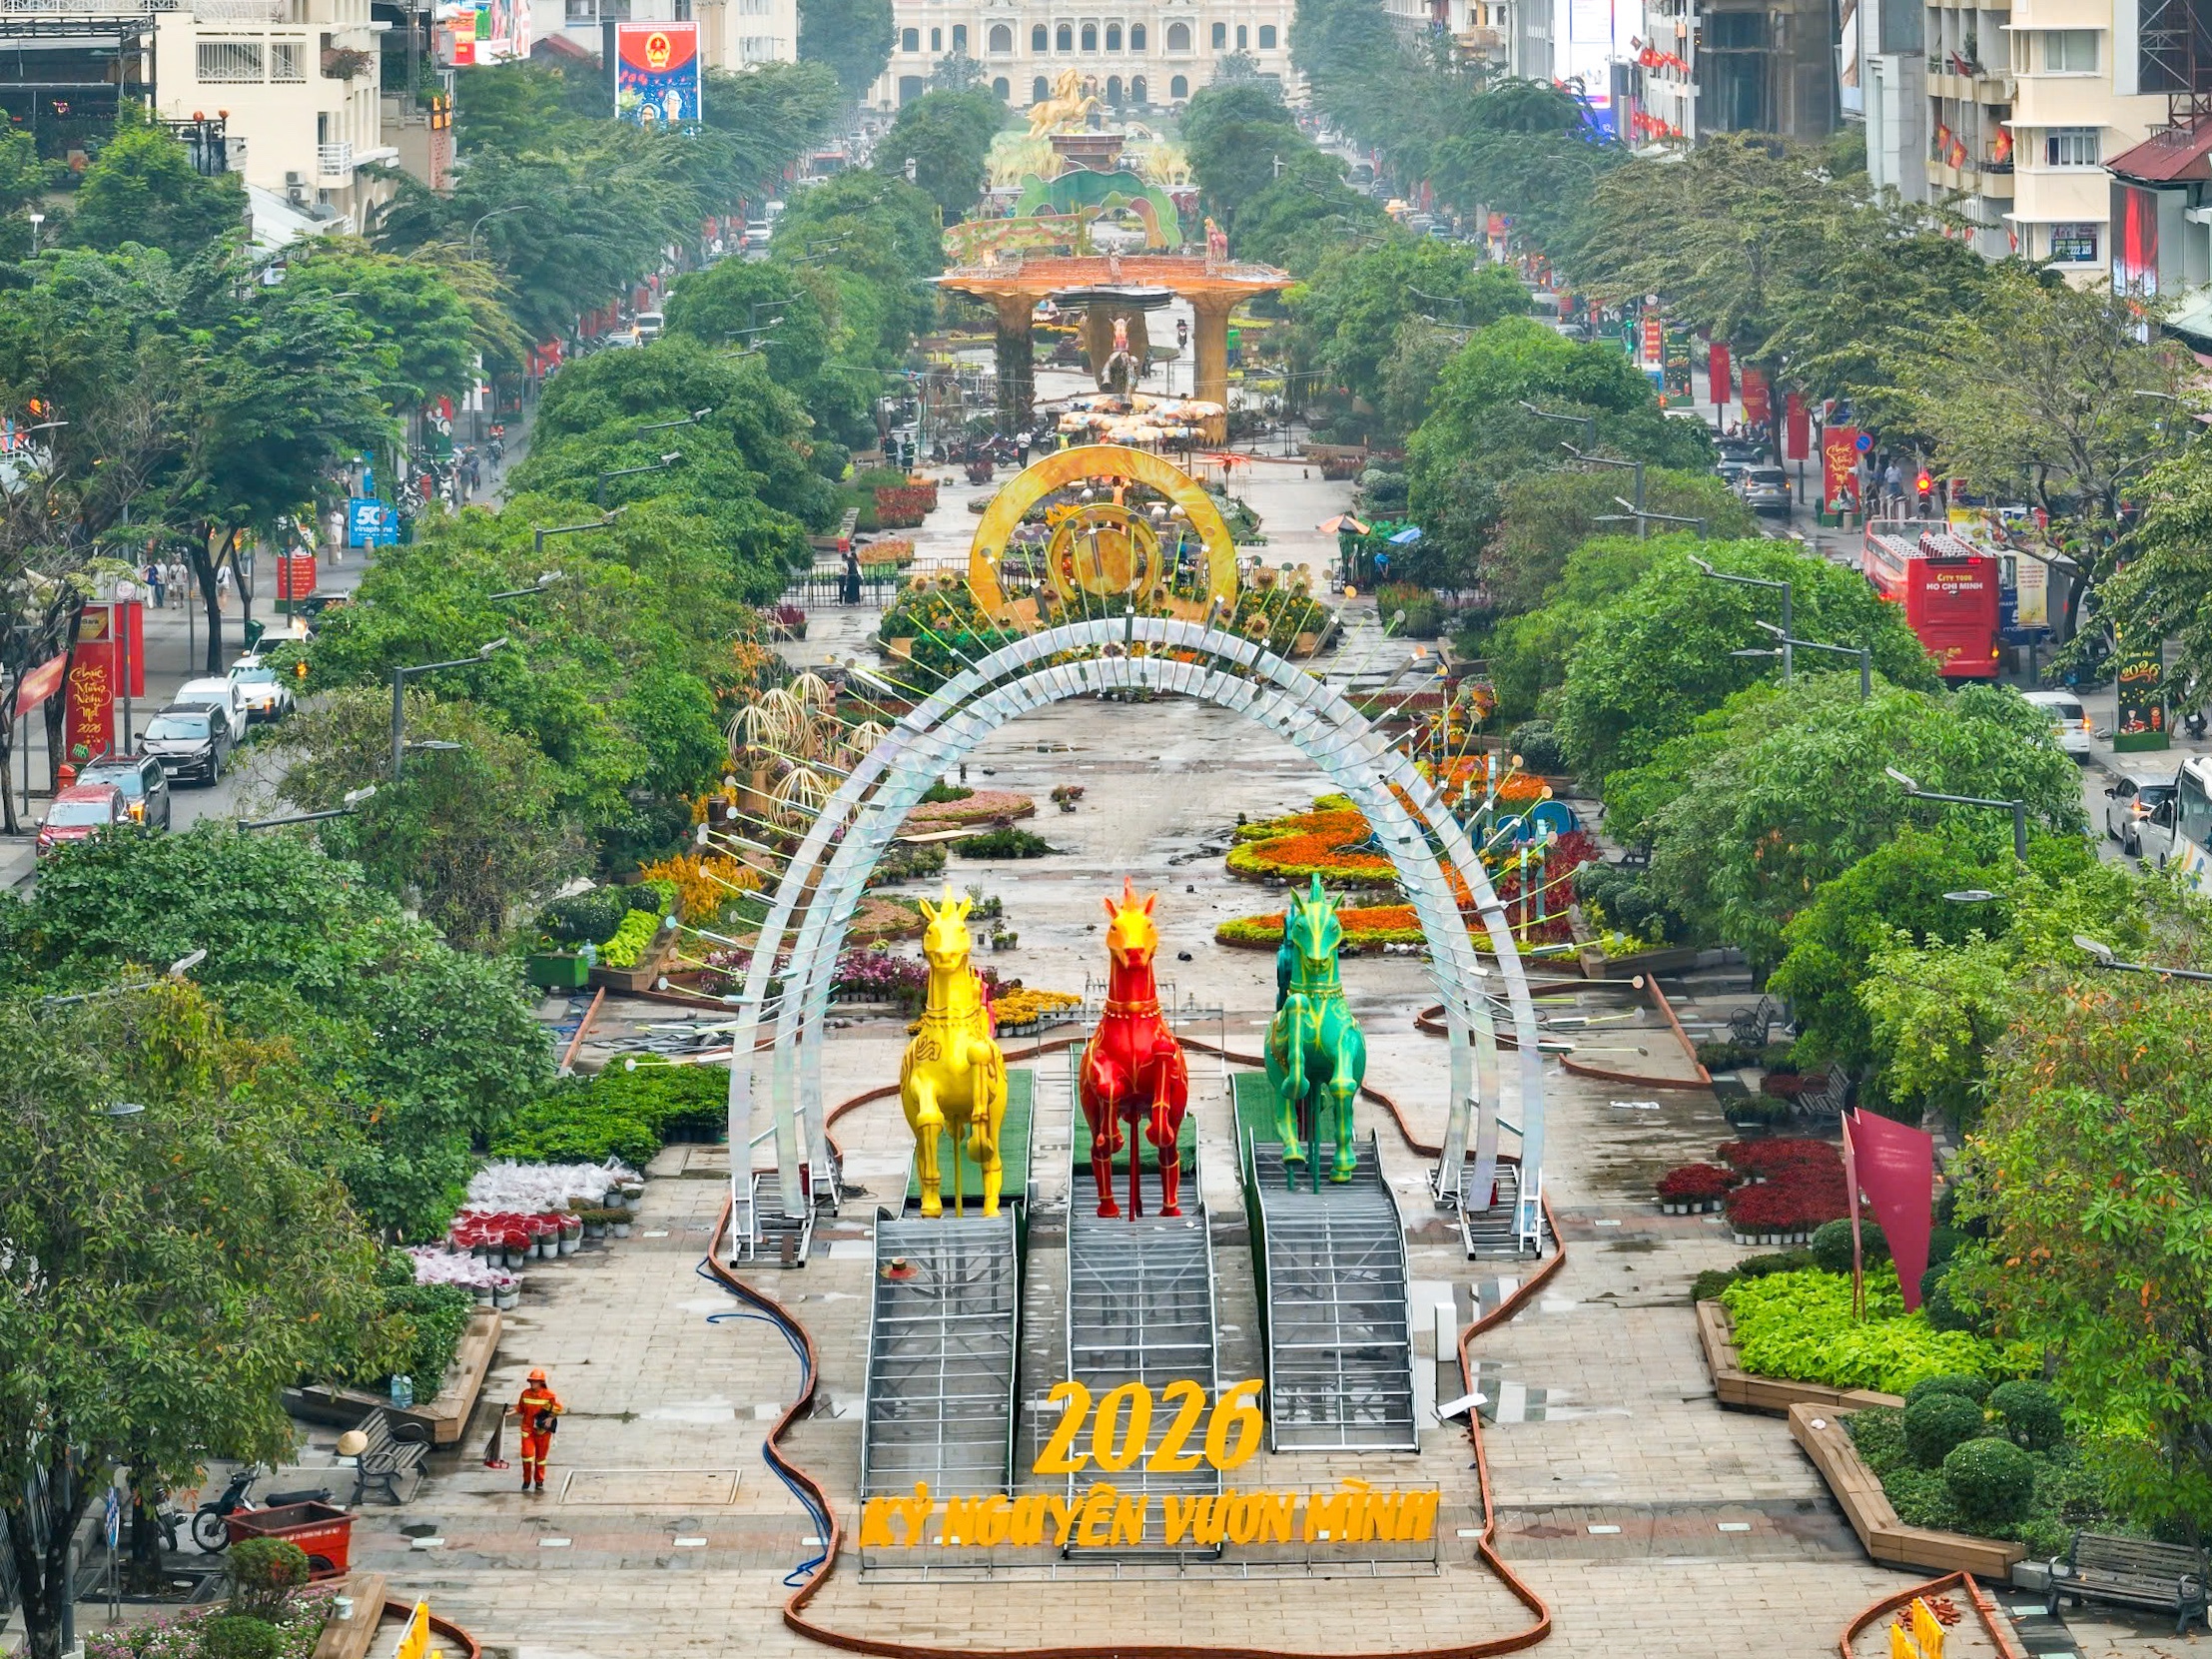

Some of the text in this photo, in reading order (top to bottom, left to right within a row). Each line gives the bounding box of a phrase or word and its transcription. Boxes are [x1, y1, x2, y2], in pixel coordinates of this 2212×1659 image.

[1959, 581, 1983, 590] MINH
[2122, 660, 2161, 676] 2026
[77, 723, 102, 733] 2026
[1033, 1379, 1264, 1474] 2026
[941, 1482, 1149, 1548] NGUYÊN
[1302, 1478, 1441, 1544] MÌNH
